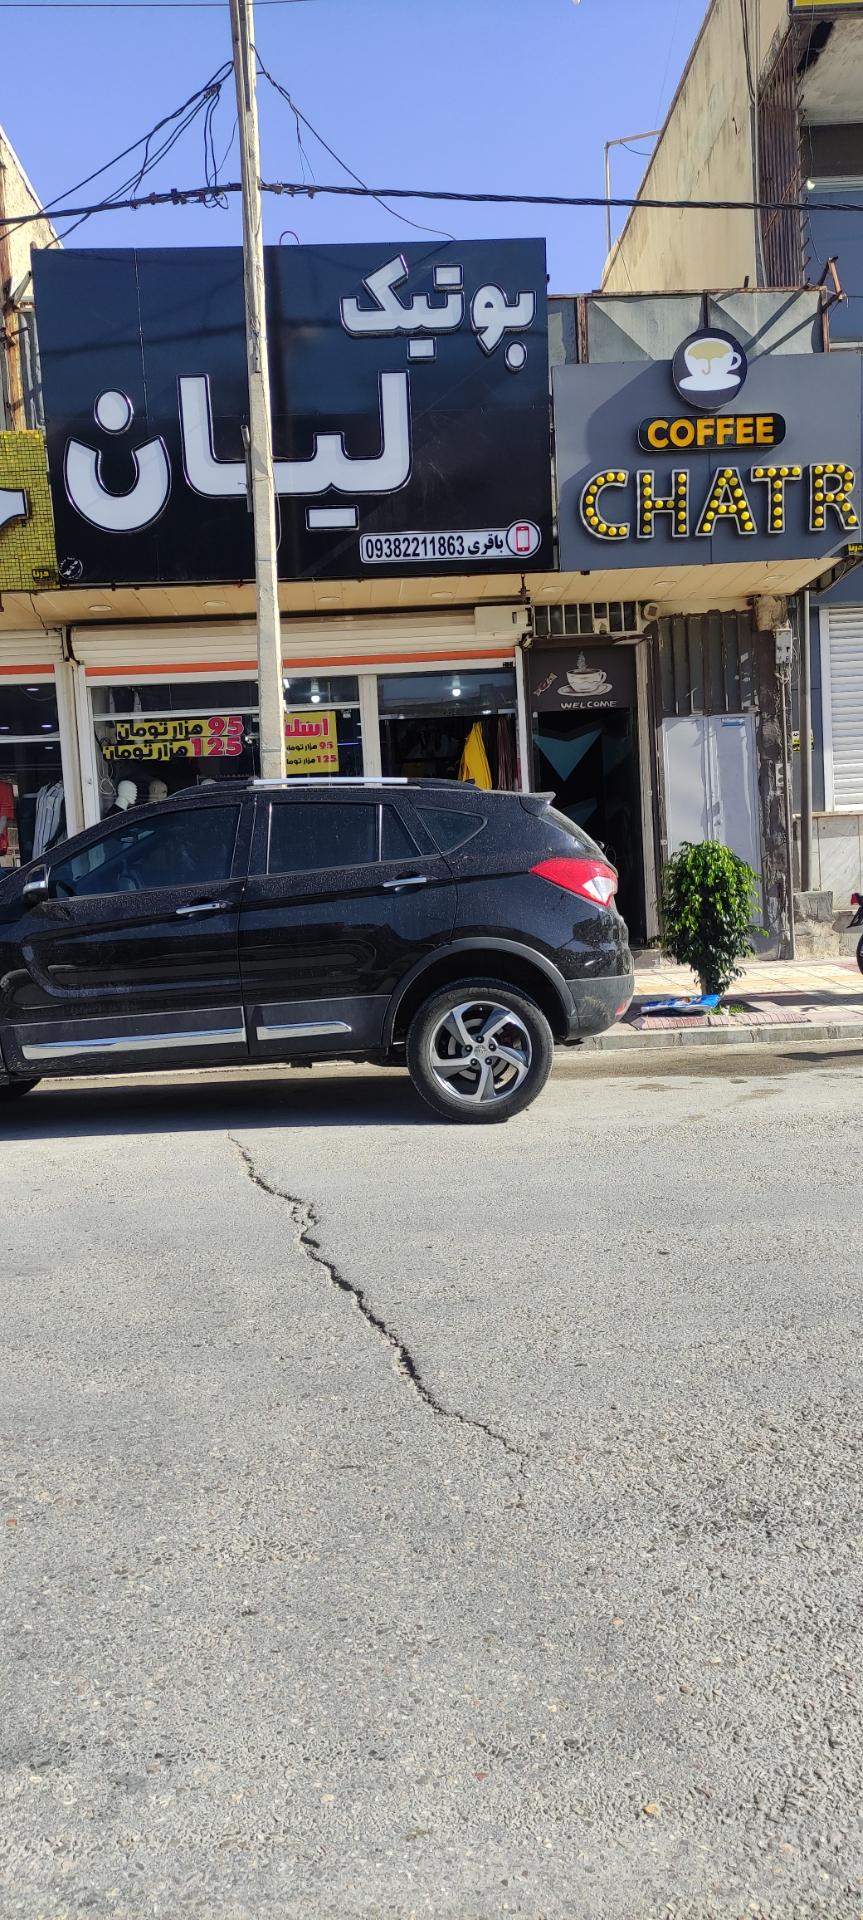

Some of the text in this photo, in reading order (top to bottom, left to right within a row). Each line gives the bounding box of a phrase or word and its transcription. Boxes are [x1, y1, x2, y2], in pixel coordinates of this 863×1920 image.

[340, 254, 537, 373] بوتیک
[647, 416, 775, 448] COFFEE
[64, 369, 413, 534] لیان
[579, 463, 861, 540] CHATR
[365, 534, 504, 559] باقری 09382211863
[560, 700, 617, 710] WELCOME
[117, 716, 245, 740] 95 هزار تومان
[103, 736, 243, 761] 125 هزار تومان
[286, 743, 303, 751] توما
[319, 741, 334, 750] 95
[286, 757, 302, 765] توما
[316, 754, 337, 763] 125
